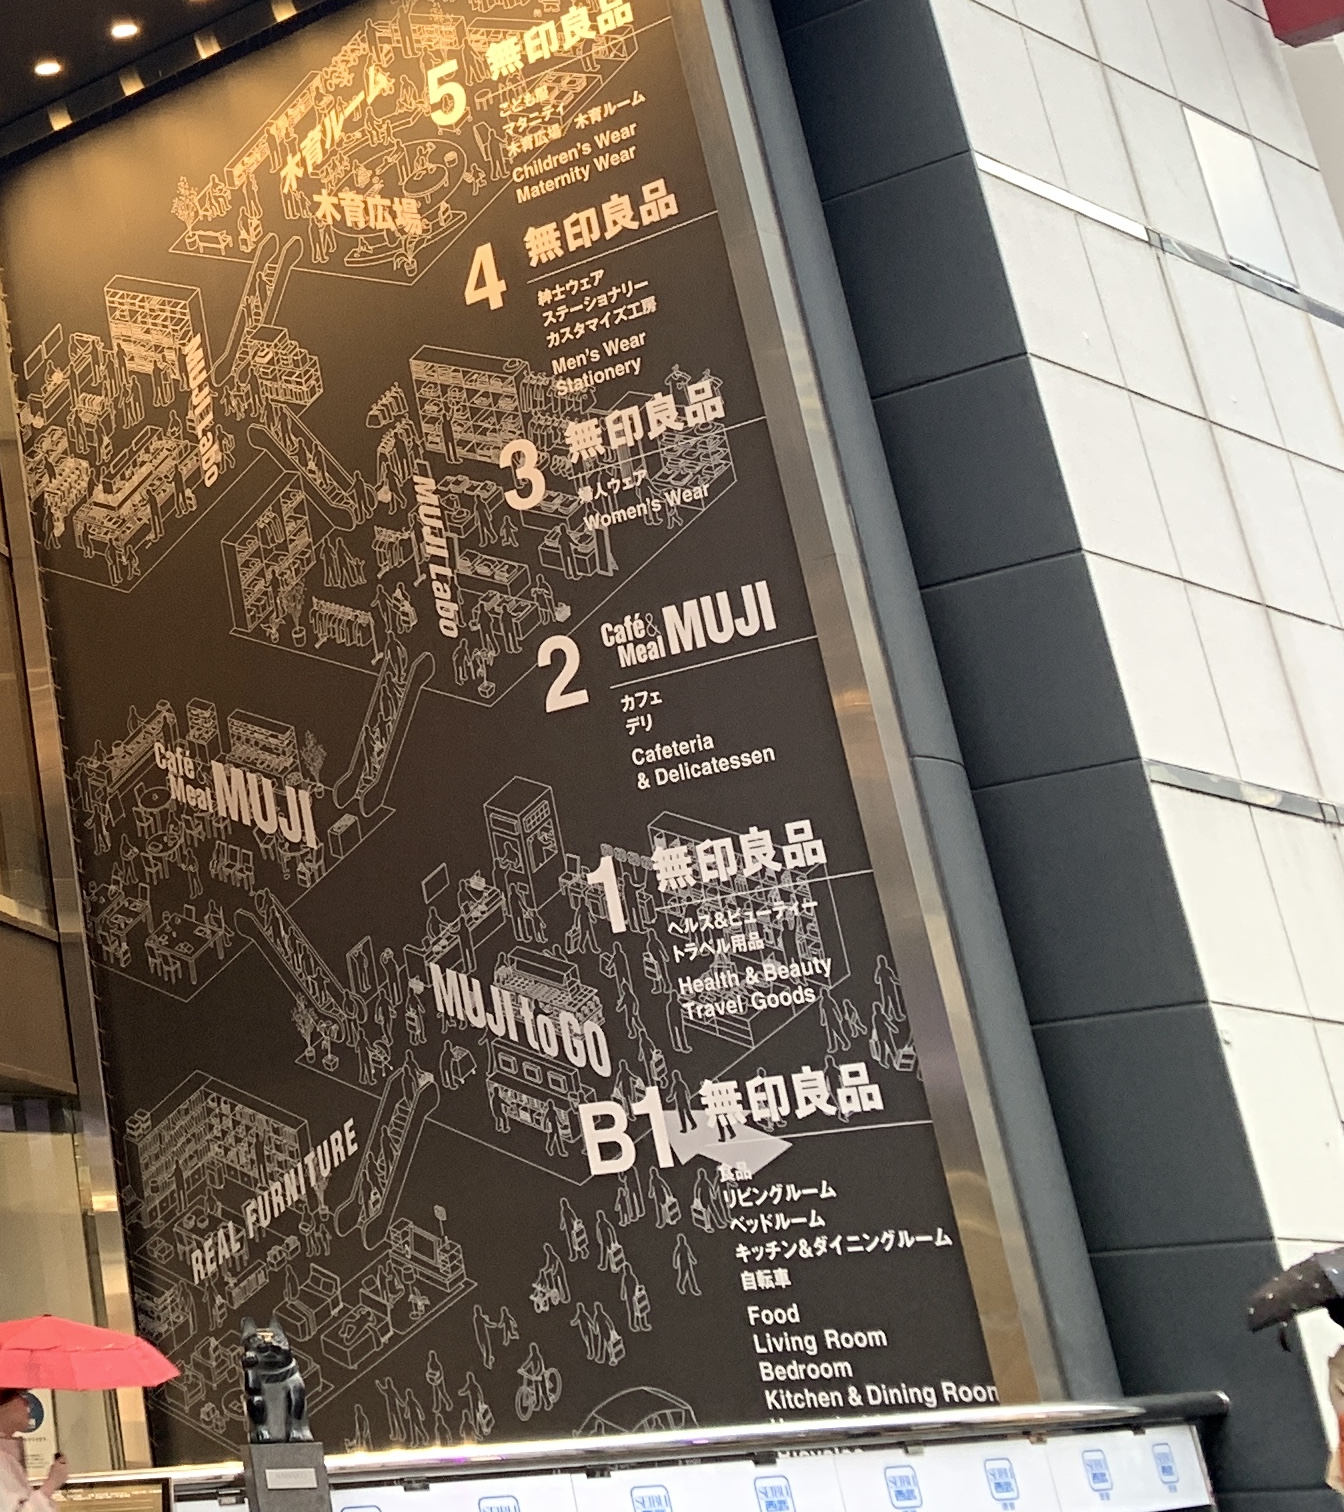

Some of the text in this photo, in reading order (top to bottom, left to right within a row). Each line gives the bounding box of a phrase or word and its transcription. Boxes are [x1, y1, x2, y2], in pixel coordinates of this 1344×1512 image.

[427, 59, 466, 125] 5
[280, 66, 389, 192] 木育ルーム
[502, 102, 565, 135] マタニティ
[506, 90, 646, 157] 木育広場 木育ルーム
[513, 123, 637, 182] Children's Wear
[516, 146, 636, 204] Maternity Wear
[313, 190, 424, 235] 木育広場
[524, 178, 678, 267] 無印良品
[464, 242, 507, 310] 4
[537, 269, 604, 306] 紳士ウェア
[542, 280, 649, 327] ステーショナリー
[546, 295, 657, 348] カスタマイズ工房
[552, 332, 646, 375] Men's Wear
[556, 357, 641, 396] Stationery
[564, 379, 725, 464] 無印良品
[197, 411, 218, 488] Labo
[499, 439, 546, 510] 3
[583, 483, 710, 531] Women's Wear
[413, 474, 459, 638] MUJI Labo
[600, 612, 662, 648] Café &
[617, 580, 778, 668] Meal MUJI
[537, 635, 589, 713] 2
[620, 690, 663, 713] カフェ
[625, 714, 653, 736] デリ
[154, 742, 195, 779] Café
[631, 734, 715, 766] Cafeteria
[636, 745, 776, 790] & Delicatessen
[168, 760, 318, 850] Meal MUJI
[651, 819, 827, 892] 無印良品
[587, 855, 627, 934] 1
[667, 900, 818, 934] ヘルス&ビューティー
[673, 932, 765, 963] トラベル用品
[678, 957, 832, 995] Health & Beauty
[430, 962, 611, 1077] MUJI to GO
[682, 985, 816, 1020] Travel Goods
[699, 1061, 884, 1128] 無印良品
[578, 1085, 675, 1176] B1
[717, 1161, 753, 1183] 食品
[723, 1179, 837, 1209] リビングルーム
[191, 1117, 358, 1285] REAL FURNITURE
[730, 1209, 826, 1234] ベッドルーム
[735, 1228, 953, 1263] キッチン&ダイニングルーム
[740, 1267, 792, 1292] 自転車
[747, 1303, 801, 1326] Food
[753, 1327, 888, 1356] Living Room
[758, 1359, 853, 1382] Bedroom
[764, 1387, 843, 1410] Kitchen
[848, 1388, 863, 1407] &
[867, 1383, 938, 1408] Dining
